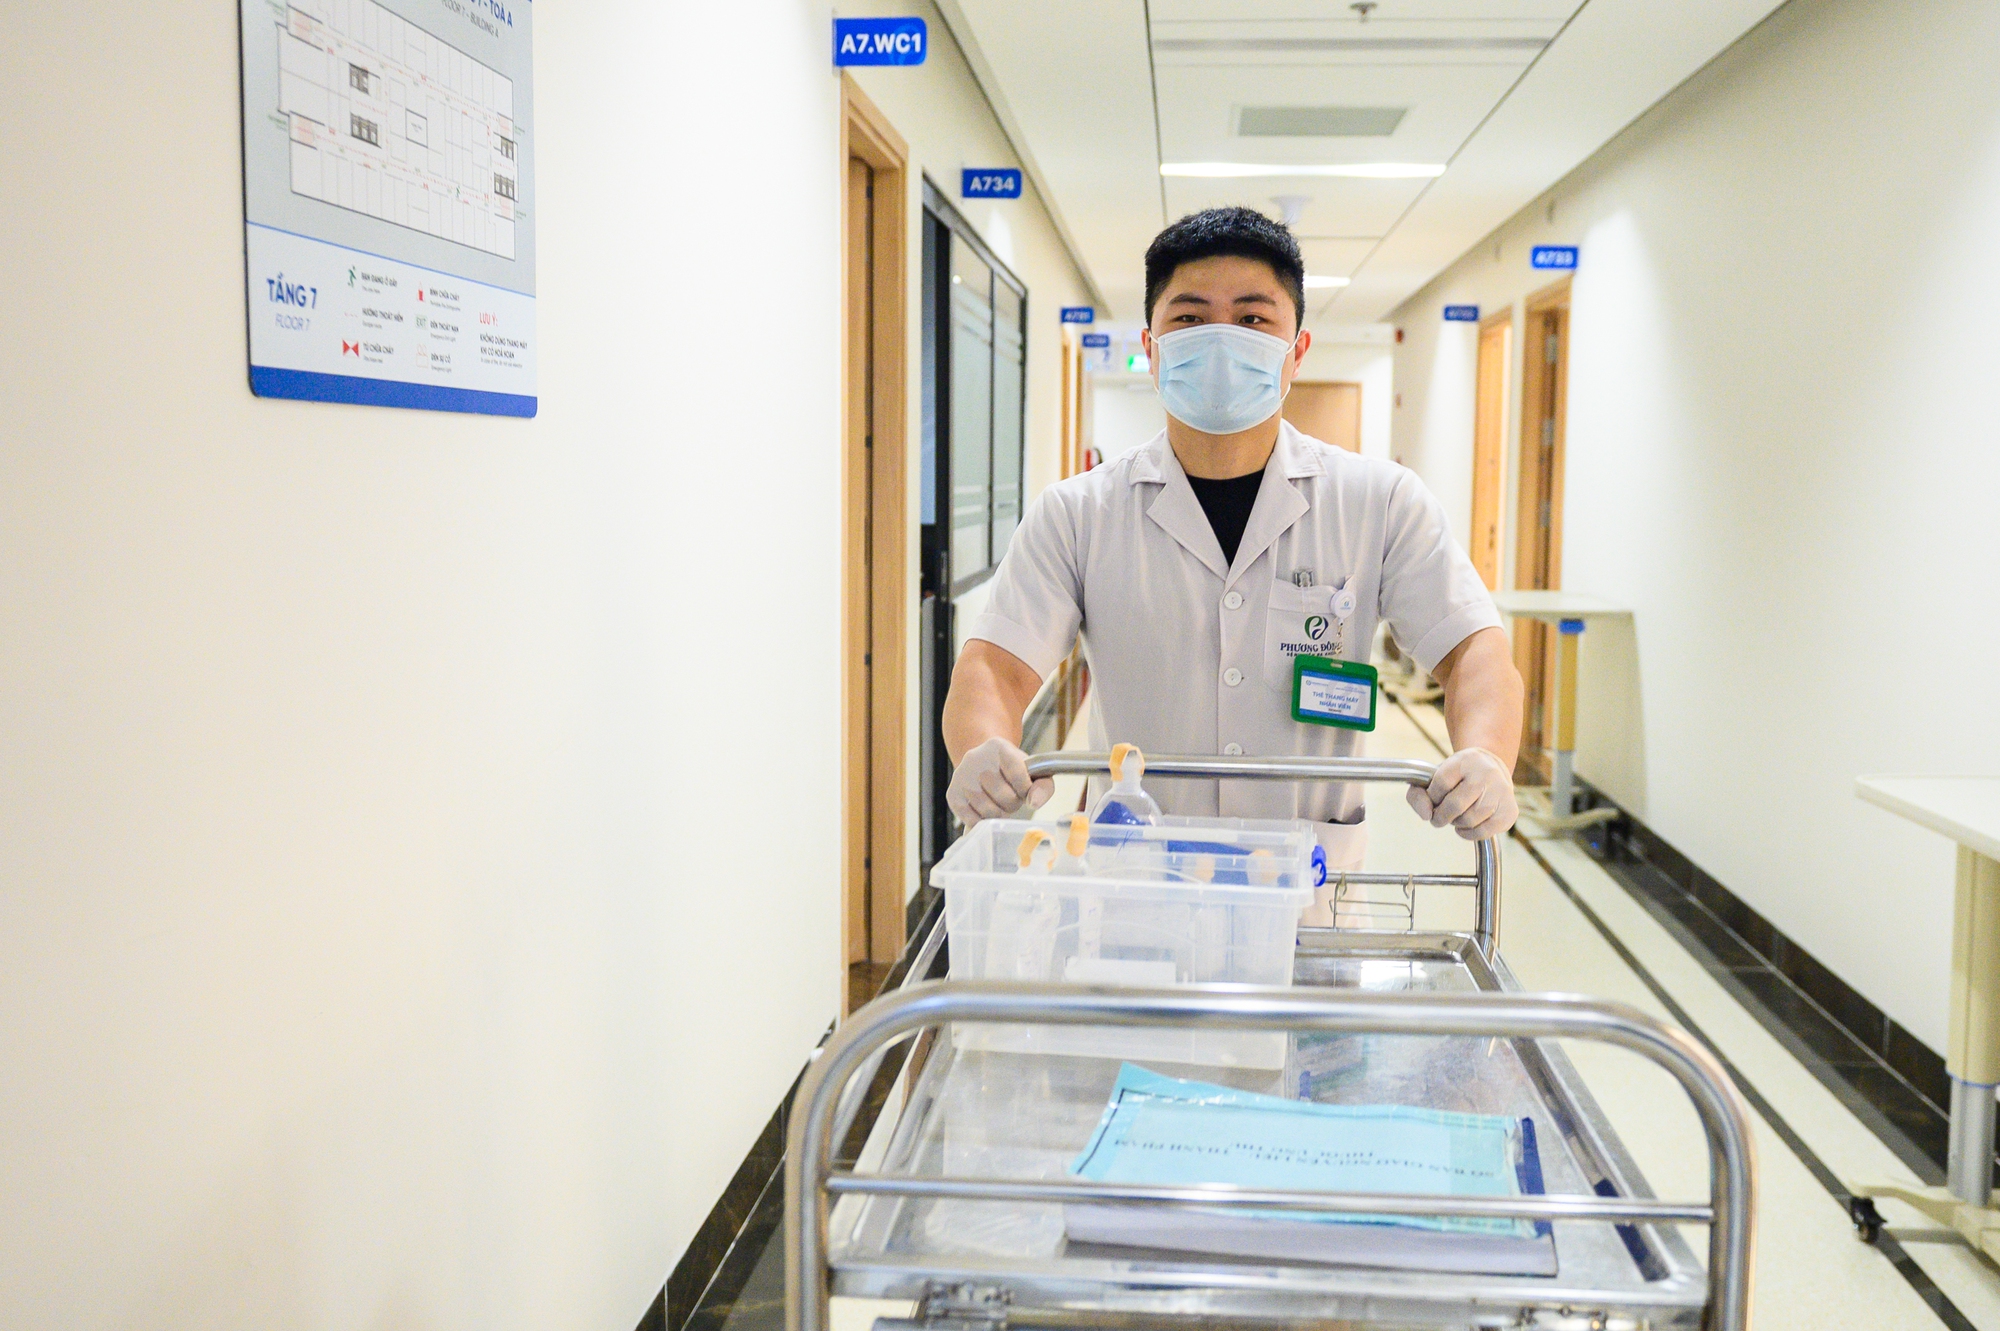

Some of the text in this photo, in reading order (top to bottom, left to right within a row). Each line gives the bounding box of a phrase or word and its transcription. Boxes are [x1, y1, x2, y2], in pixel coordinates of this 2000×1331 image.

[841, 33, 921, 54] A7.WC1
[970, 176, 1015, 192] A734
[309, 286, 317, 310] 7
[275, 313, 303, 331] FLOOR
[1280, 642, 1318, 652] PHƯƠNG
